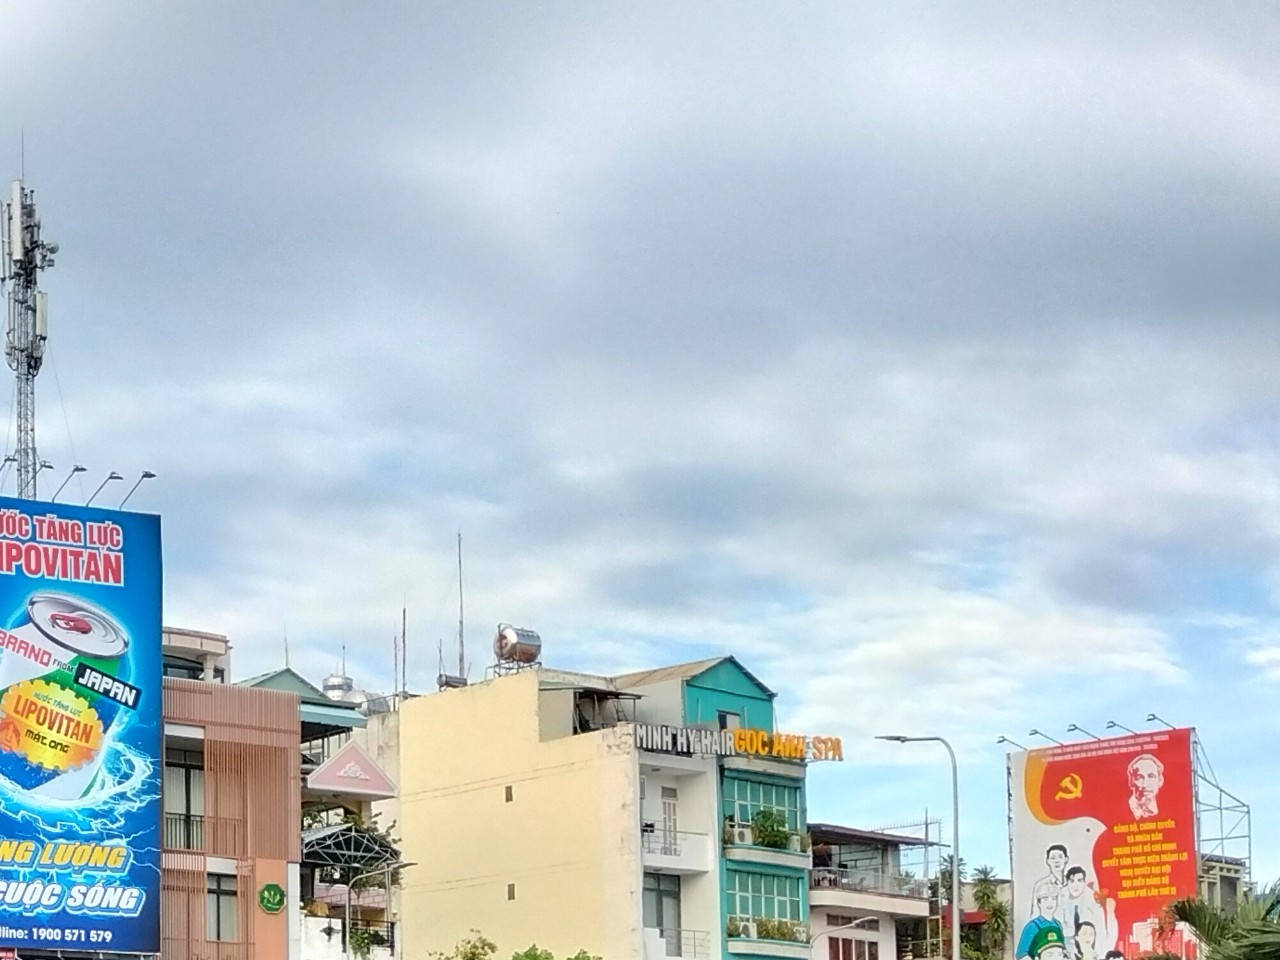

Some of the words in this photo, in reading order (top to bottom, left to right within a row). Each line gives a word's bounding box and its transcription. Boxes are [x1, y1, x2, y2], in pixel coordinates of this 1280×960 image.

[33, 514, 84, 546] TĂNG
[86, 521, 123, 551] LỰC
[77, 667, 137, 707] JAPAN
[13, 695, 94, 744] LIPOVITAN
[636, 724, 672, 751] MINH
[701, 730, 735, 756] HAIR
[812, 735, 844, 762] SPA
[39, 841, 128, 872] LƯỢNG
[67, 878, 140, 910] SỐNG
[32, 927, 62, 941] 1900
[64, 929, 86, 942] 571
[89, 930, 113, 943] 579
